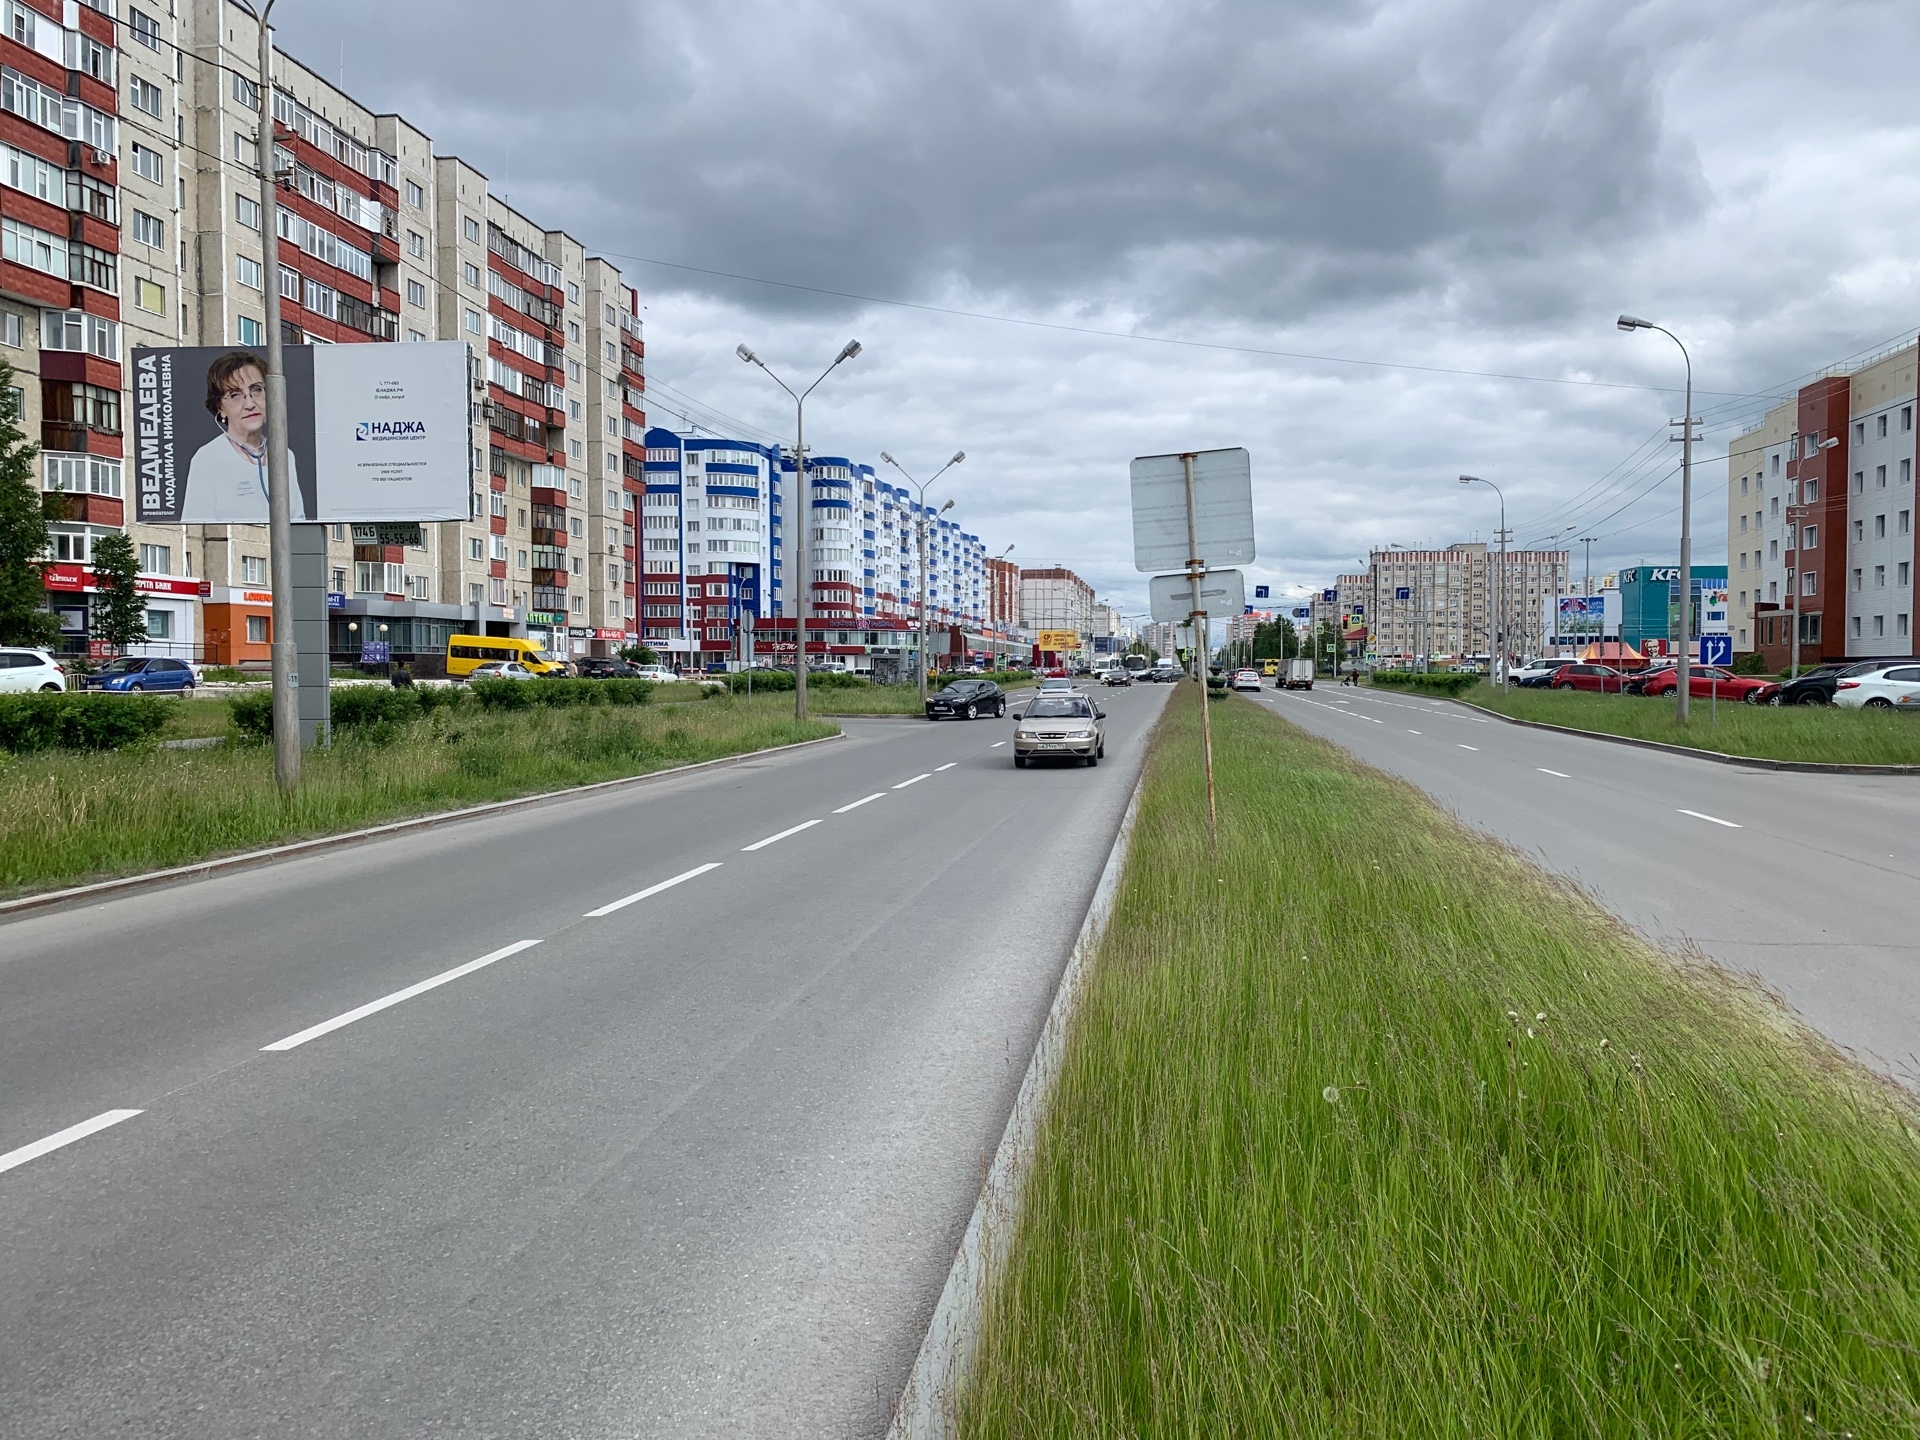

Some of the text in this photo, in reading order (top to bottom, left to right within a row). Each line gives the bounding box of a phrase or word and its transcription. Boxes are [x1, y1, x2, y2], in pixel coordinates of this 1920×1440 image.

[138, 354, 163, 509] ВЕДМЕДЕВА
[161, 354, 176, 509] ЛЮДМИЛА НИКОЛАЕВНА
[371, 421, 426, 435] НАДЖА
[379, 532, 419, 545] 55-55-66
[1623, 570, 1636, 584] KFC
[154, 581, 172, 591] БАНК
[243, 591, 273, 603] LOREN
[526, 612, 553, 624] АПТЕКА
[642, 640, 669, 648] ОПТИМА
